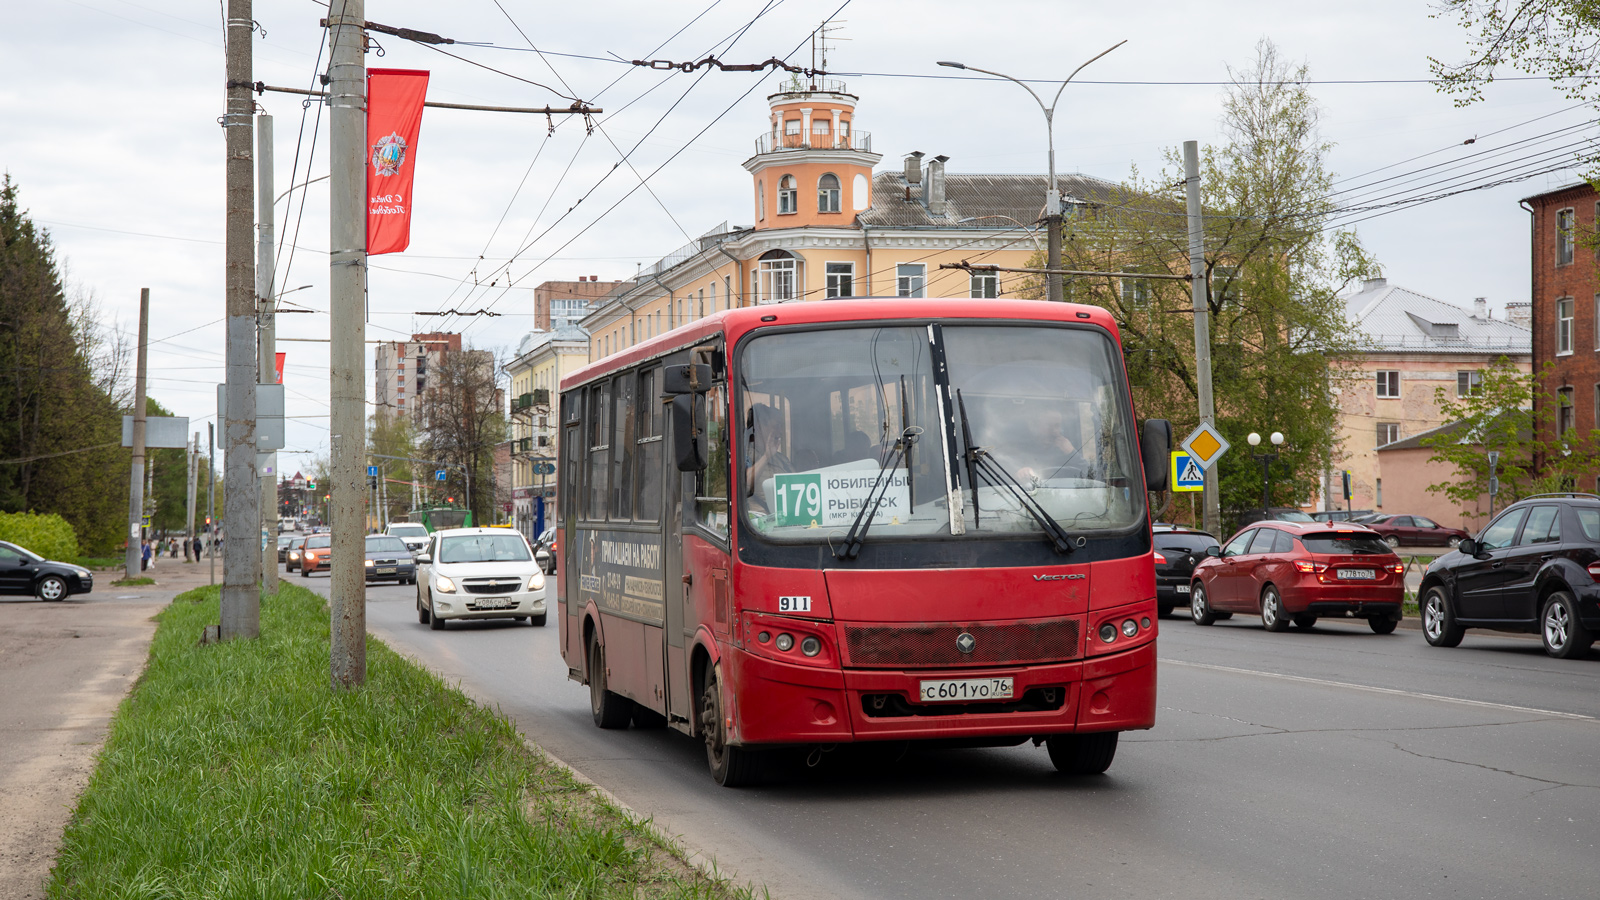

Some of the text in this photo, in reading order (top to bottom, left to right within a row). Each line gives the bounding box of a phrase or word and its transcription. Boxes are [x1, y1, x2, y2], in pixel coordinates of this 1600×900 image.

[777, 482, 821, 517] 179
[828, 496, 898, 510] РЫБИНСК
[828, 512, 848, 520] (МКР
[602, 540, 660, 570] ПРИГЛАШАЕМ НА РАБОТУ
[780, 597, 808, 610] 911
[992, 680, 1008, 692] 76
